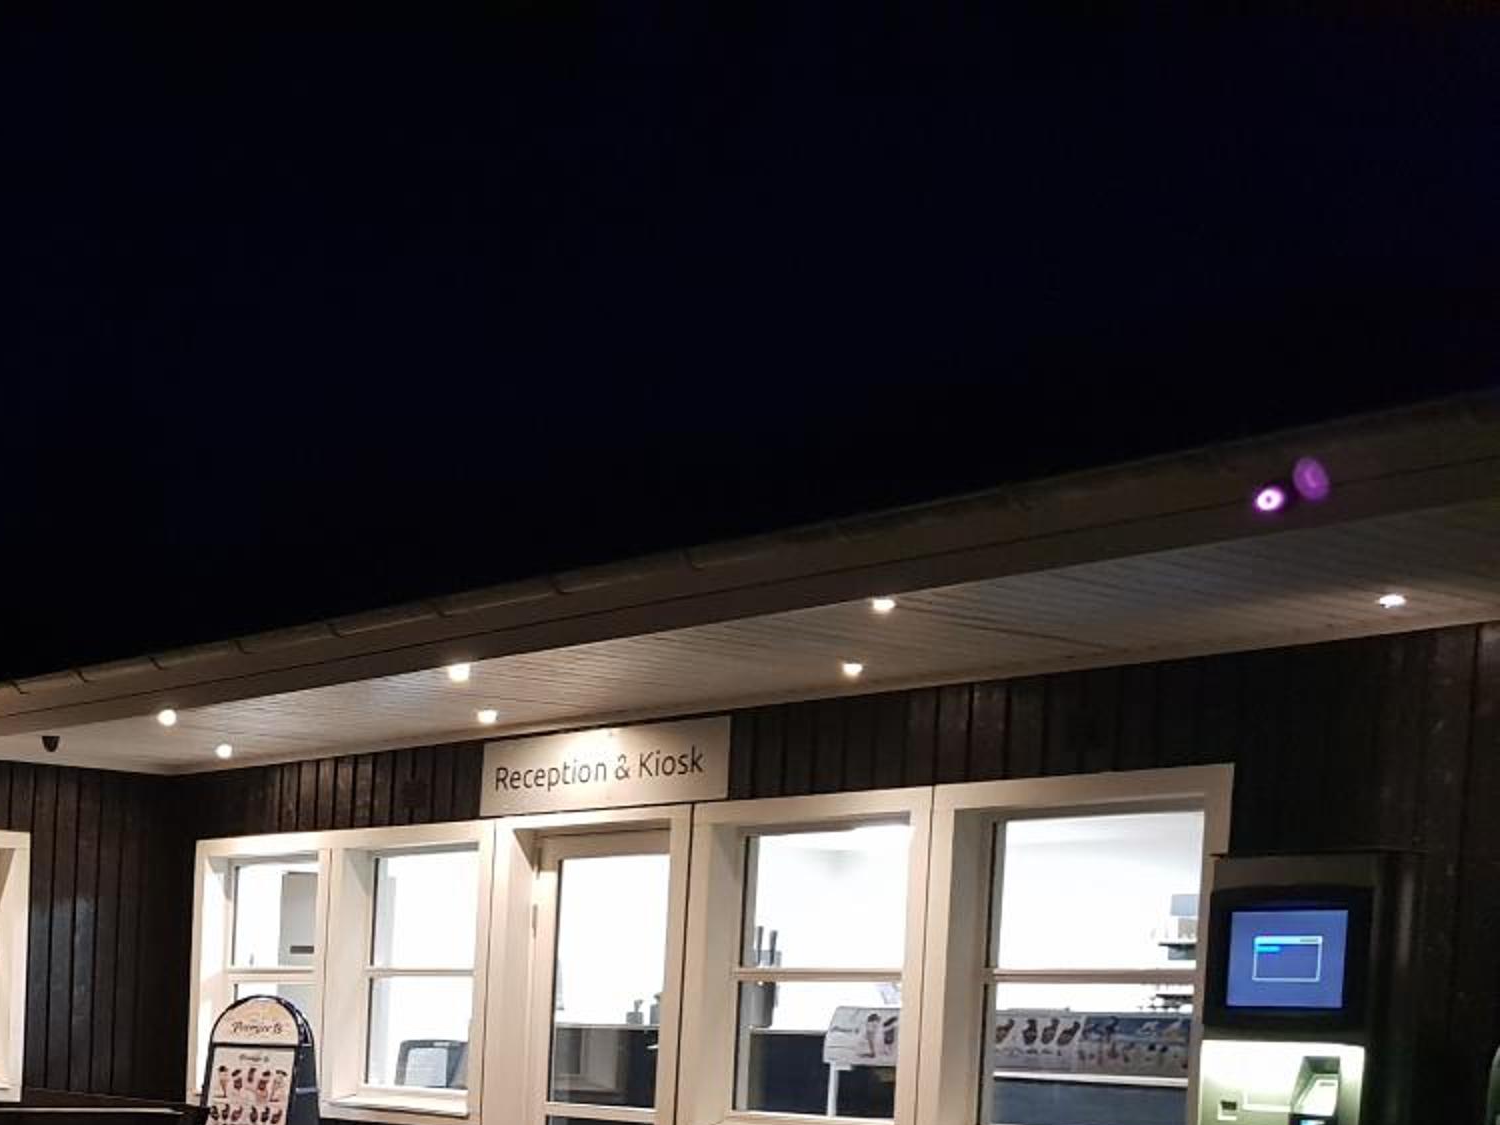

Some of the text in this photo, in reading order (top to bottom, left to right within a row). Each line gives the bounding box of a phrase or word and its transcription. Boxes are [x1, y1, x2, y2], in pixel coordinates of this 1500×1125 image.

[494, 744, 703, 792] Reception & Kiosk
